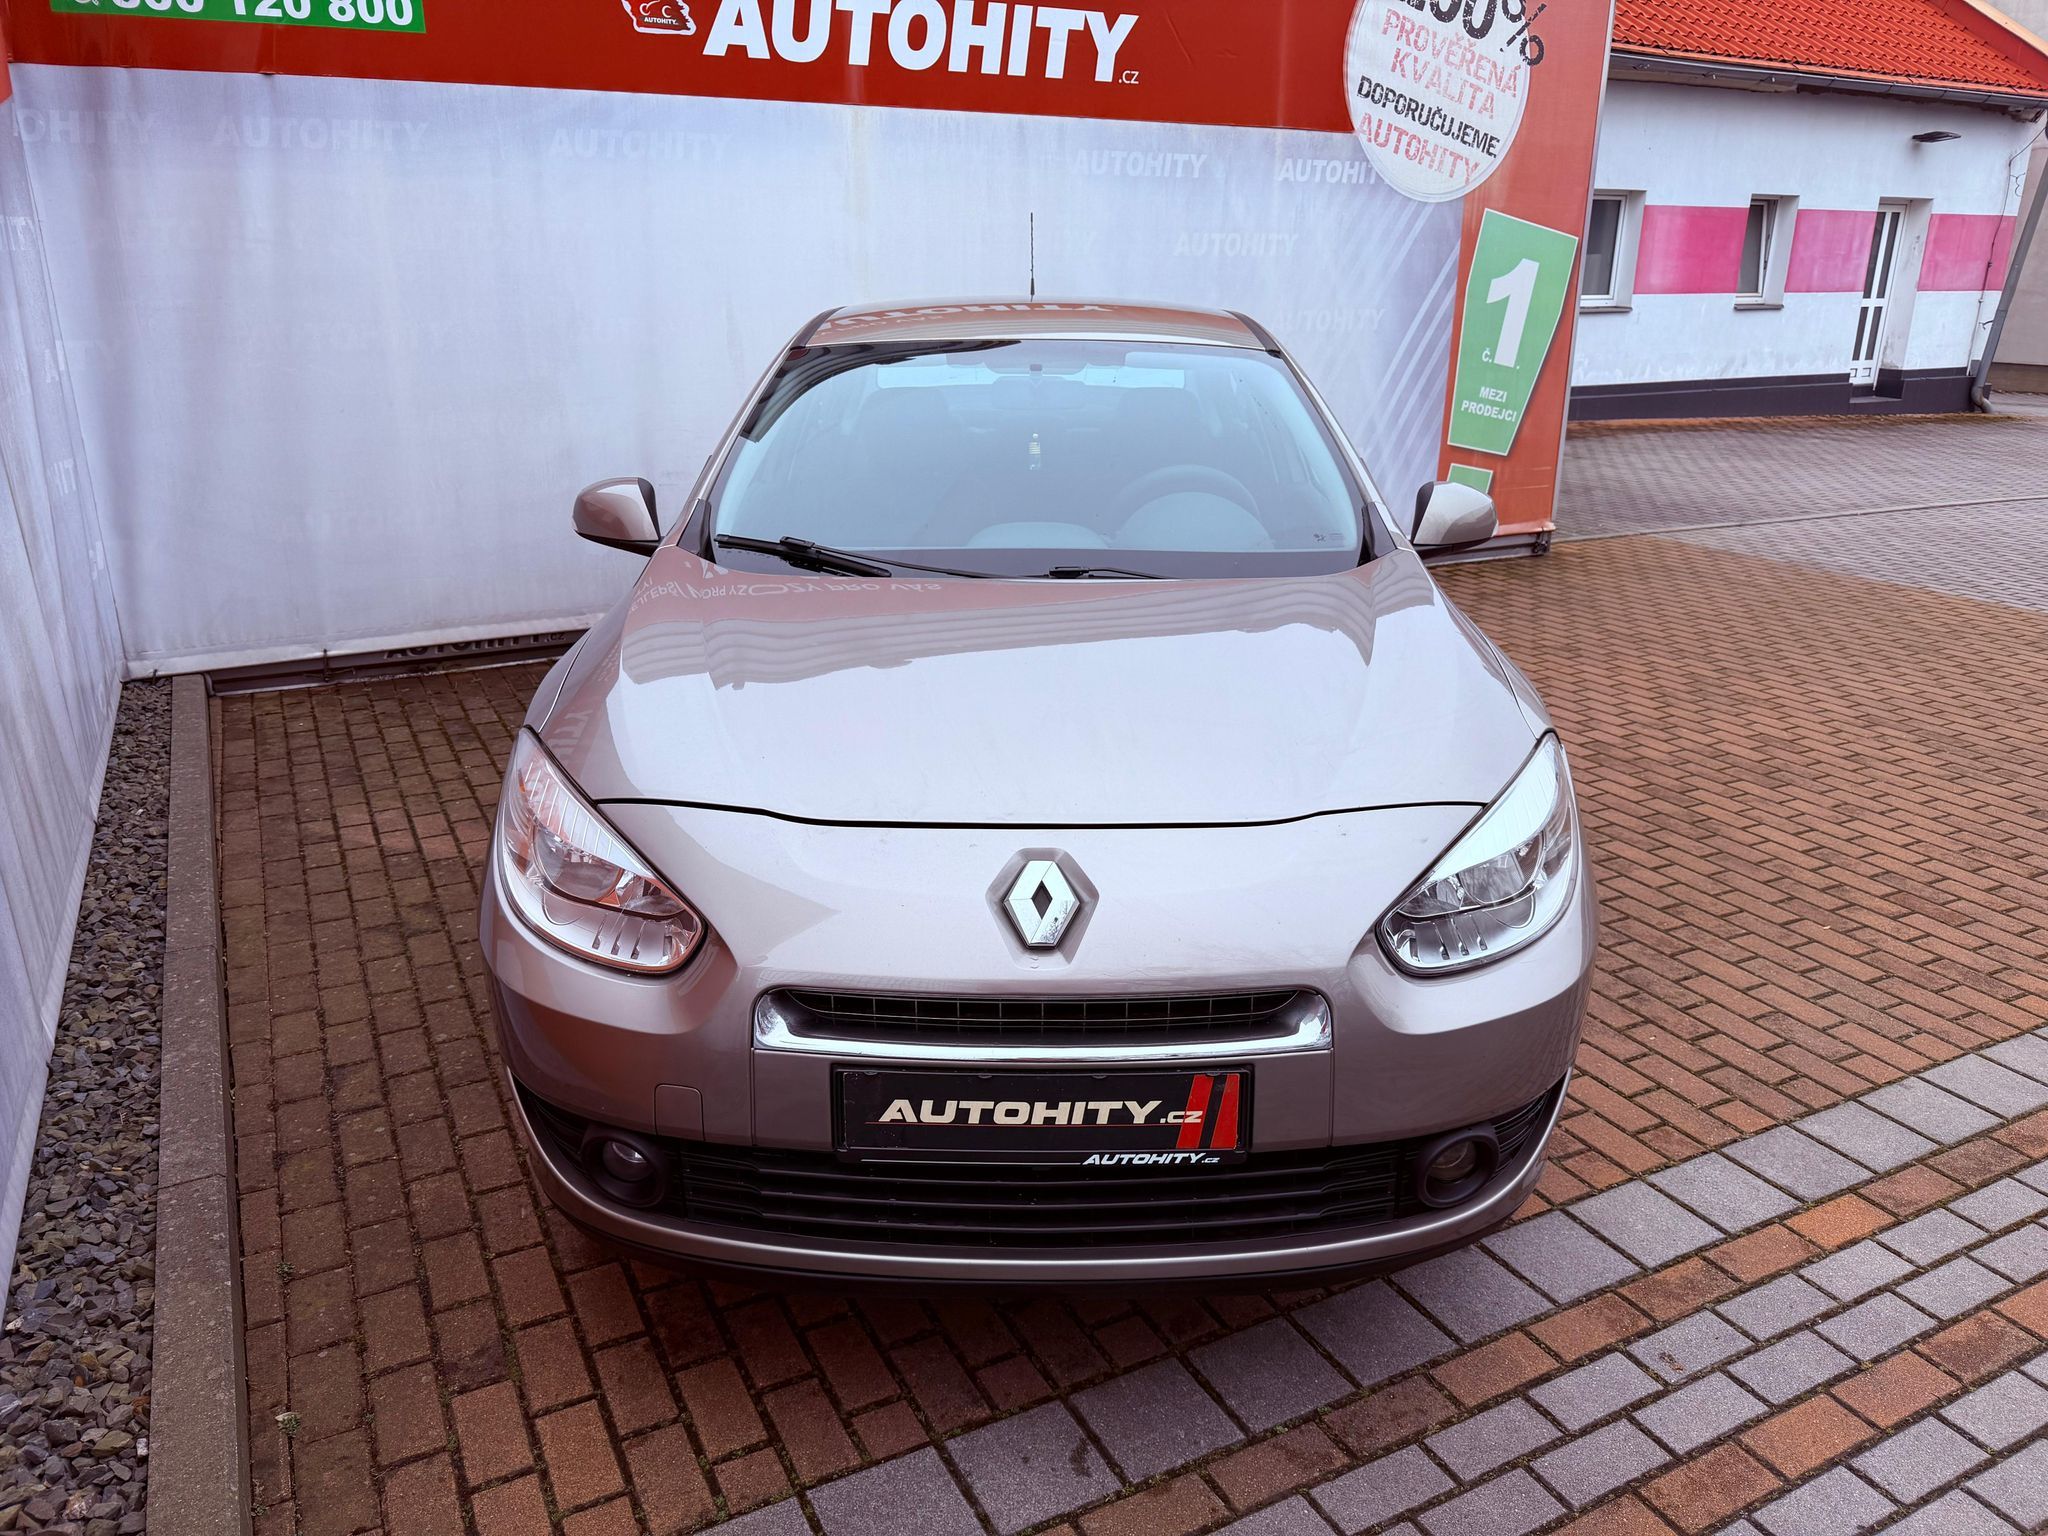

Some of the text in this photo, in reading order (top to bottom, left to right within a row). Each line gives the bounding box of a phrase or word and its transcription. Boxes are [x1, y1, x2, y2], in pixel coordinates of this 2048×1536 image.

[1391, 48, 1495, 119] KVALITA
[1357, 75, 1500, 158] DOPORUČUJEME
[1072, 149, 1207, 179] AUTOHITY
[1359, 112, 1480, 186] AUTOHITY
[1277, 157, 1388, 184] AUTOHIT
[1480, 386, 1507, 403] MEZI
[1461, 399, 1517, 422] PRODEJCI
